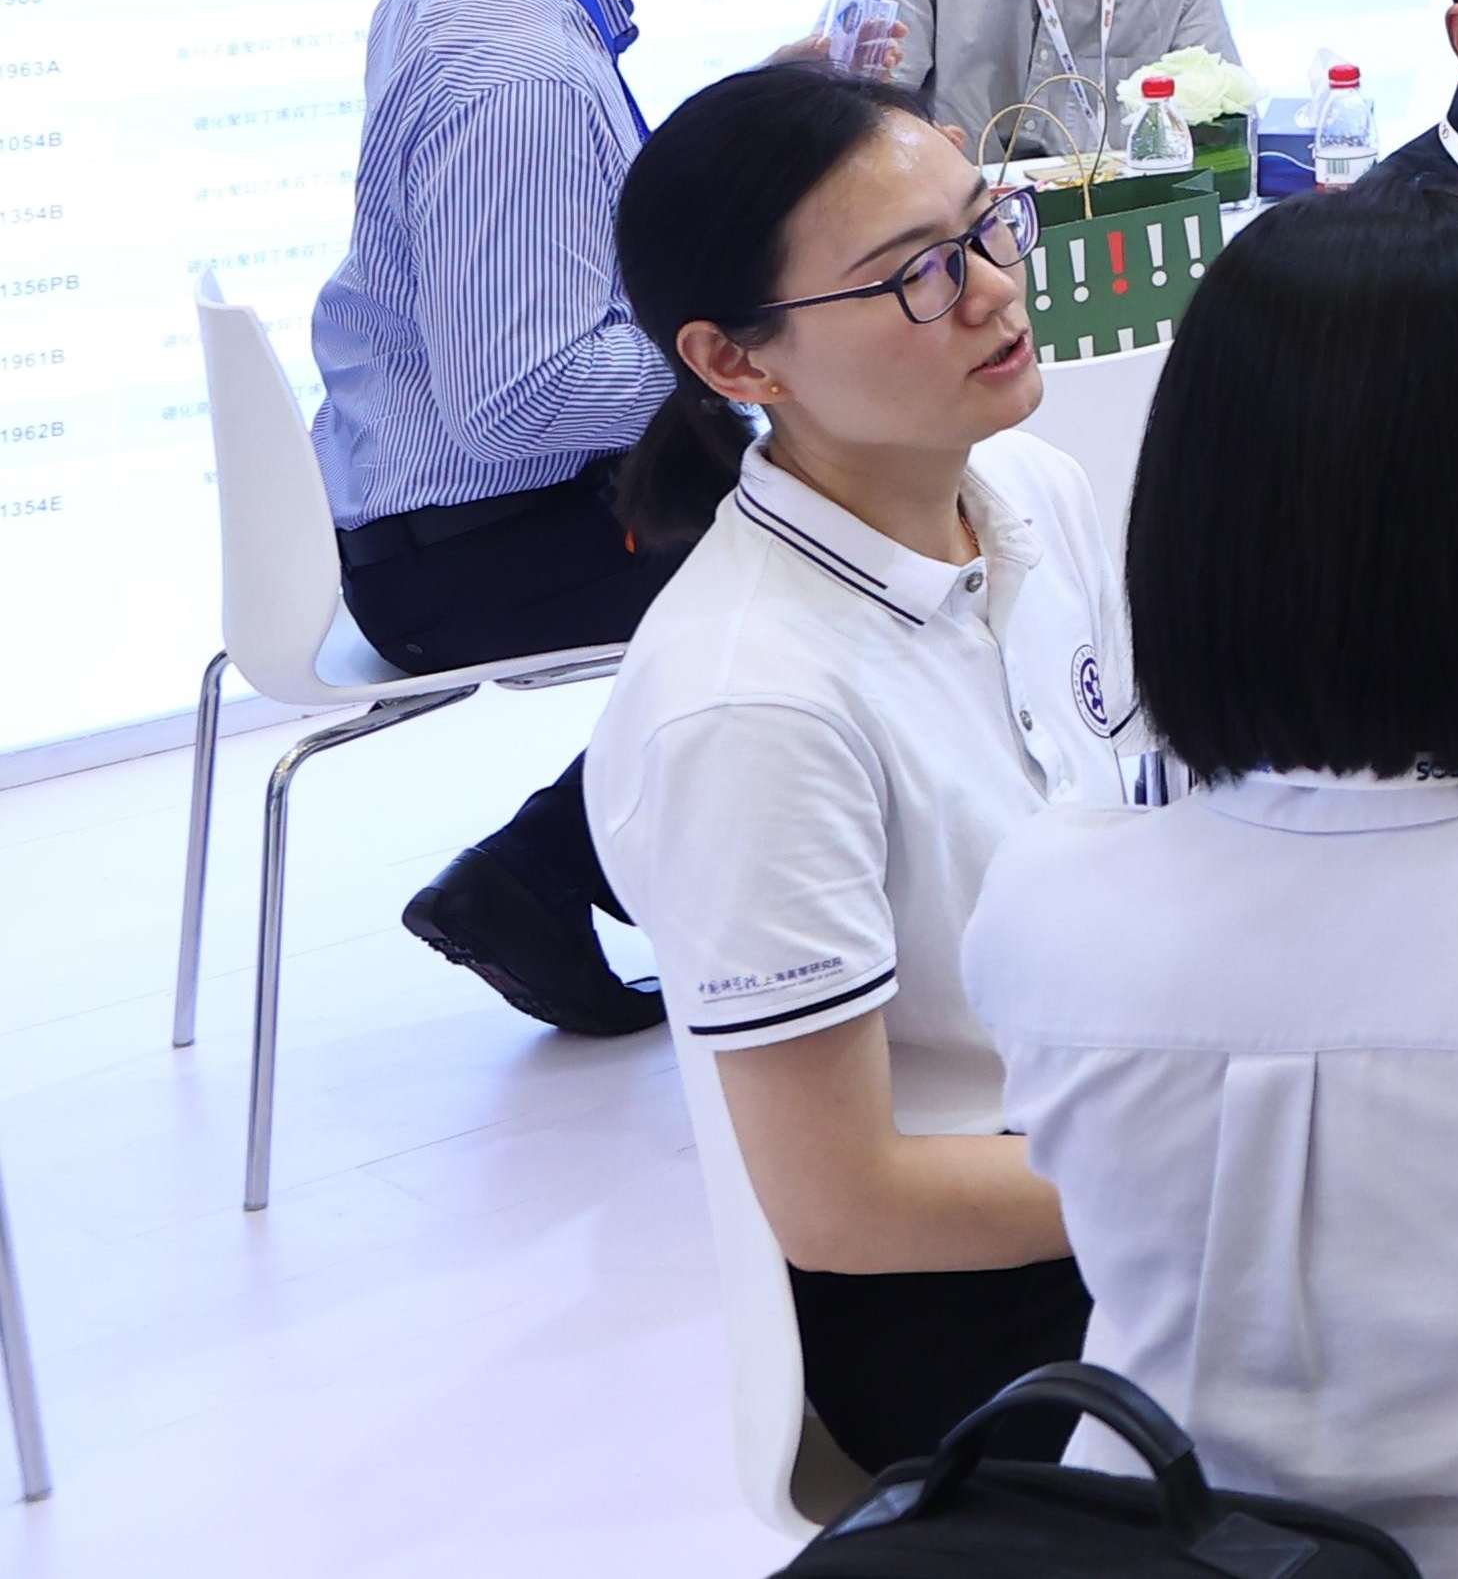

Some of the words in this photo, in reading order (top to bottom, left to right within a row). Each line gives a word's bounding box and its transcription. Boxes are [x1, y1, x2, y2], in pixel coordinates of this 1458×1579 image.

[0, 274, 80, 298] 1356PB
[0, 349, 65, 372] 1961B
[0, 421, 65, 444] 1962B
[0, 495, 63, 518] 1354E
